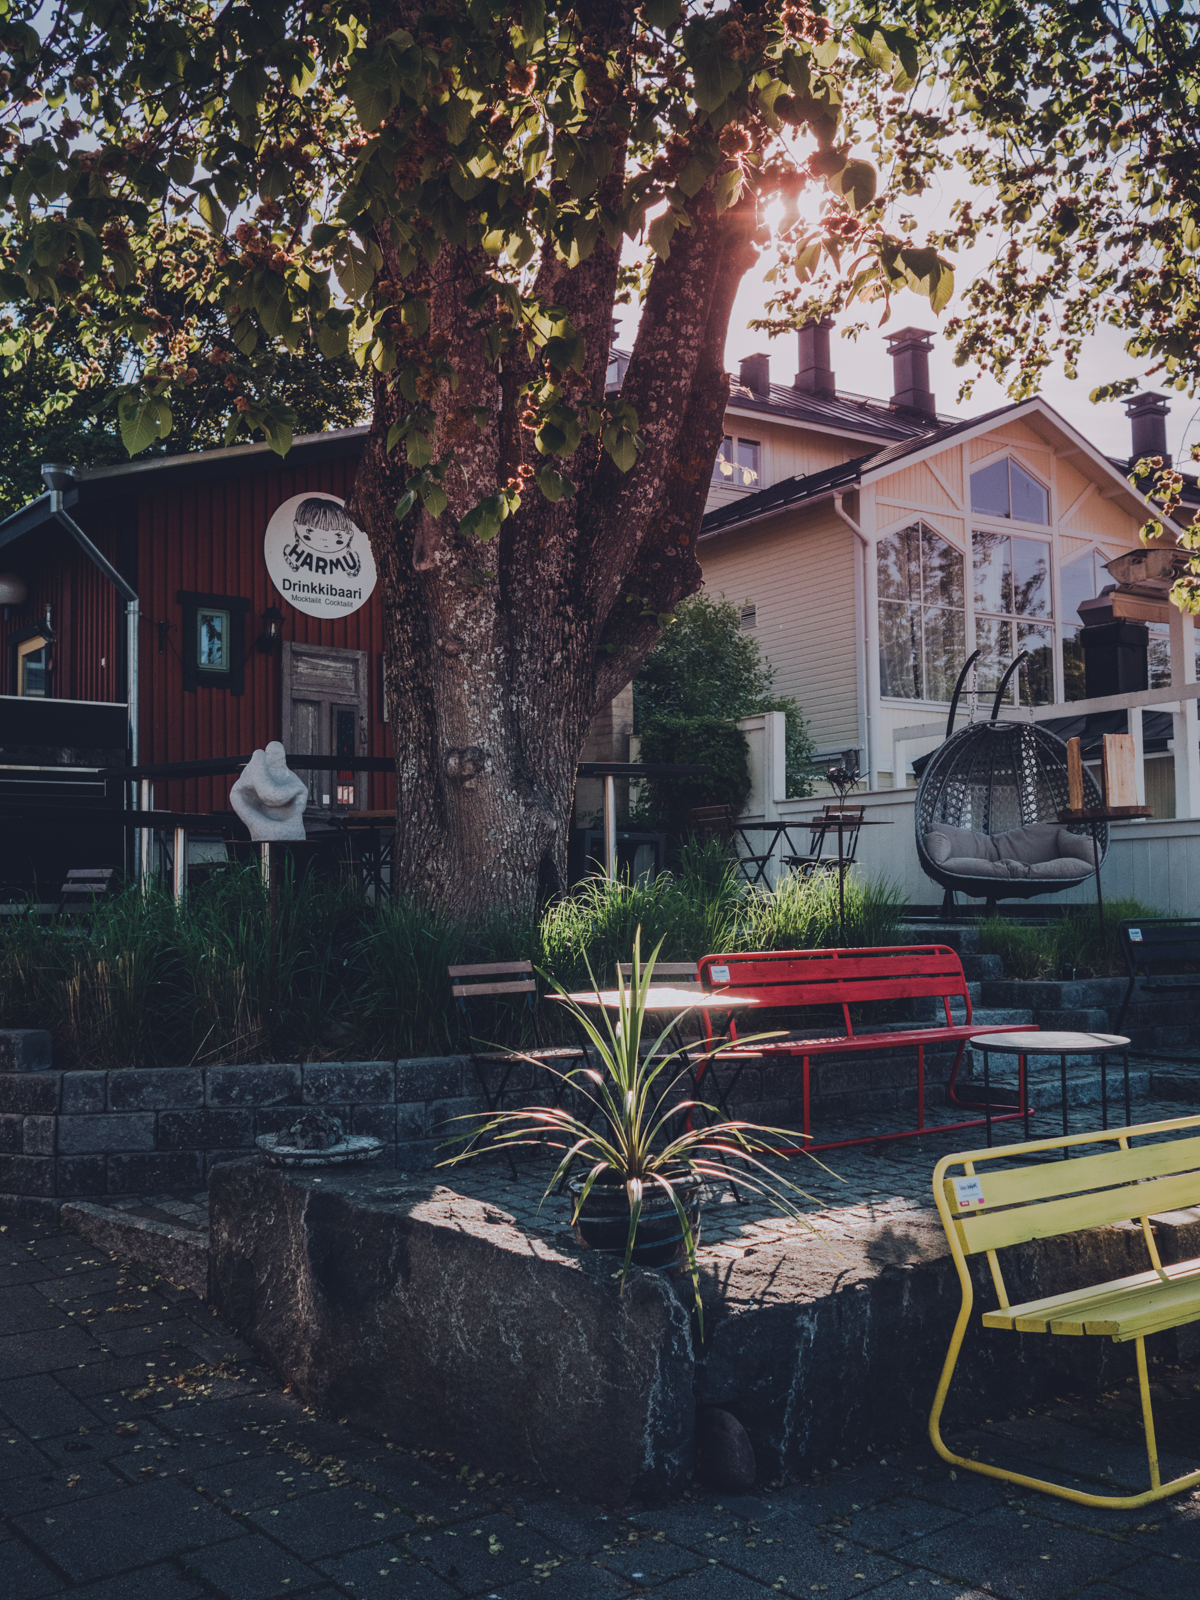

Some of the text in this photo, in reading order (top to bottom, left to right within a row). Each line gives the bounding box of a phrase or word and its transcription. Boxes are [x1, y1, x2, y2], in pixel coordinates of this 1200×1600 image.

[288, 544, 358, 575] HARMU
[282, 578, 362, 600] Drinkkibaari
[291, 594, 354, 608] Mocktailit Cocktailit
